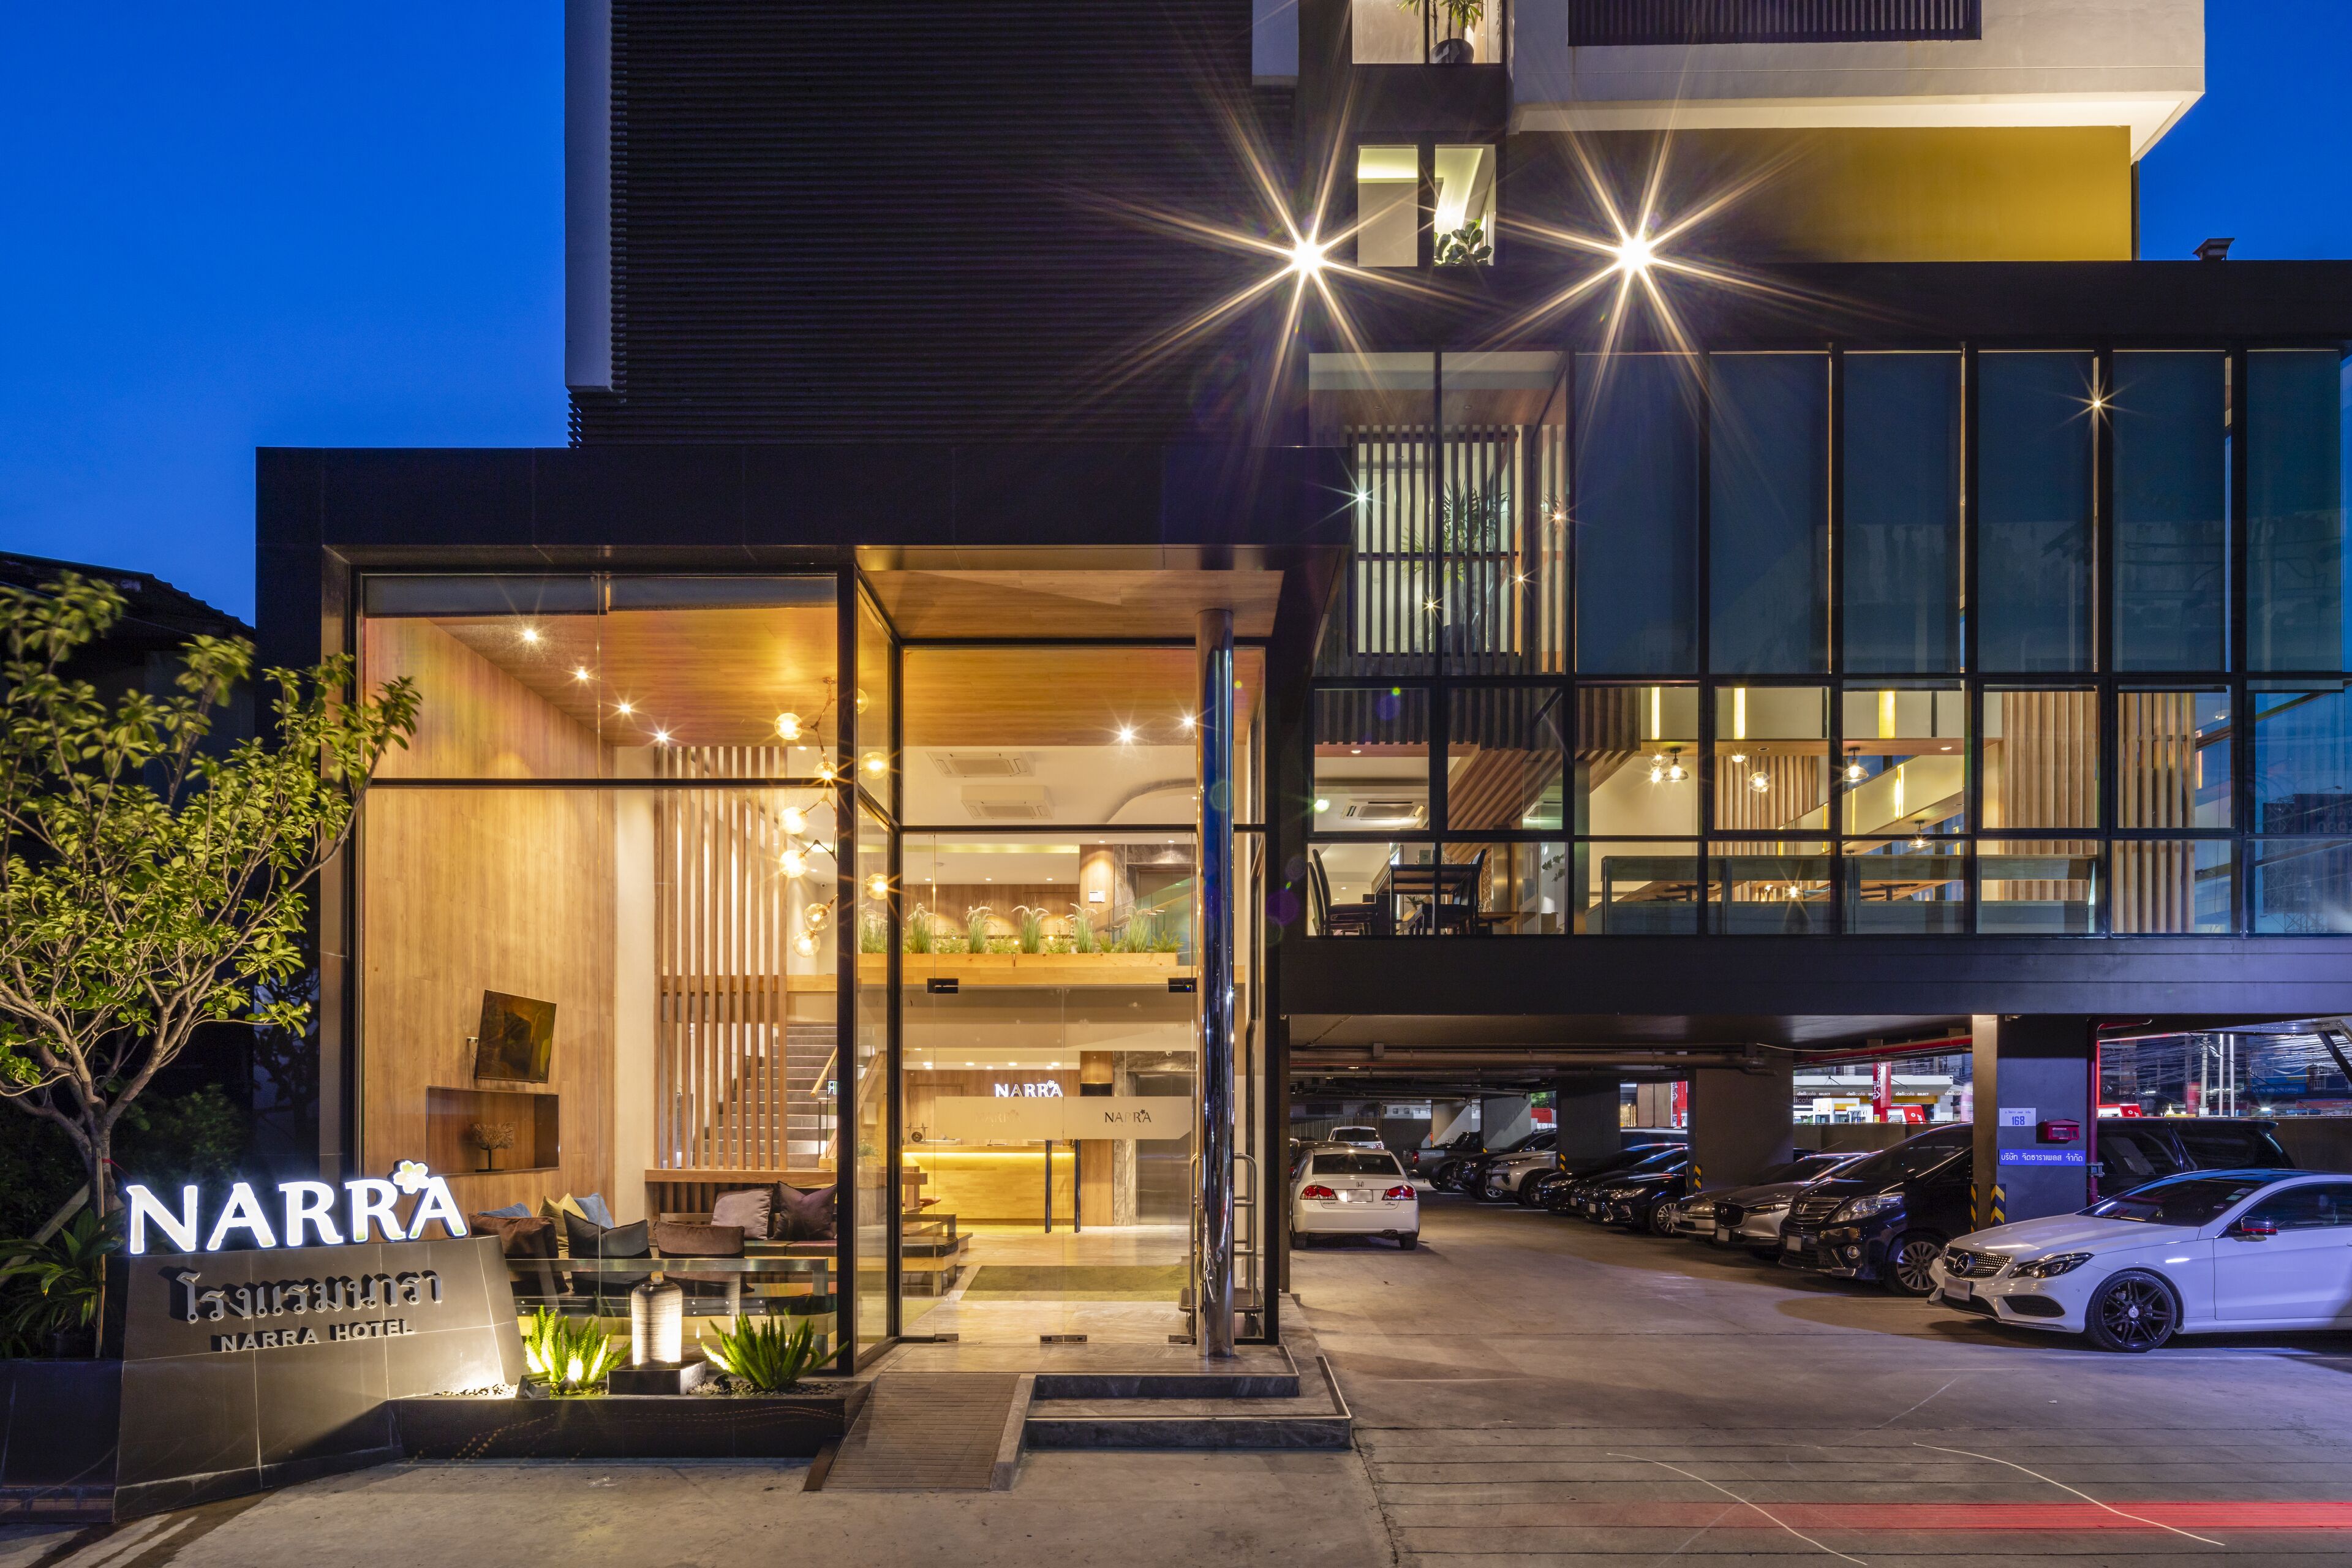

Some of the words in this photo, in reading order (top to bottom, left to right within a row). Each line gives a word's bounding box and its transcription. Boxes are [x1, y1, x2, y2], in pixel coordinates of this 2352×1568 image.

[995, 1083, 1064, 1098] NARRA
[2012, 1116, 2025, 1126] 168
[2065, 1153, 2083, 1162] จำกัด
[126, 1175, 469, 1254] NARRA
[176, 1270, 442, 1324] โรงแรมนารา
[221, 1328, 319, 1352] NARRA
[335, 1319, 416, 1341] HOTEL
